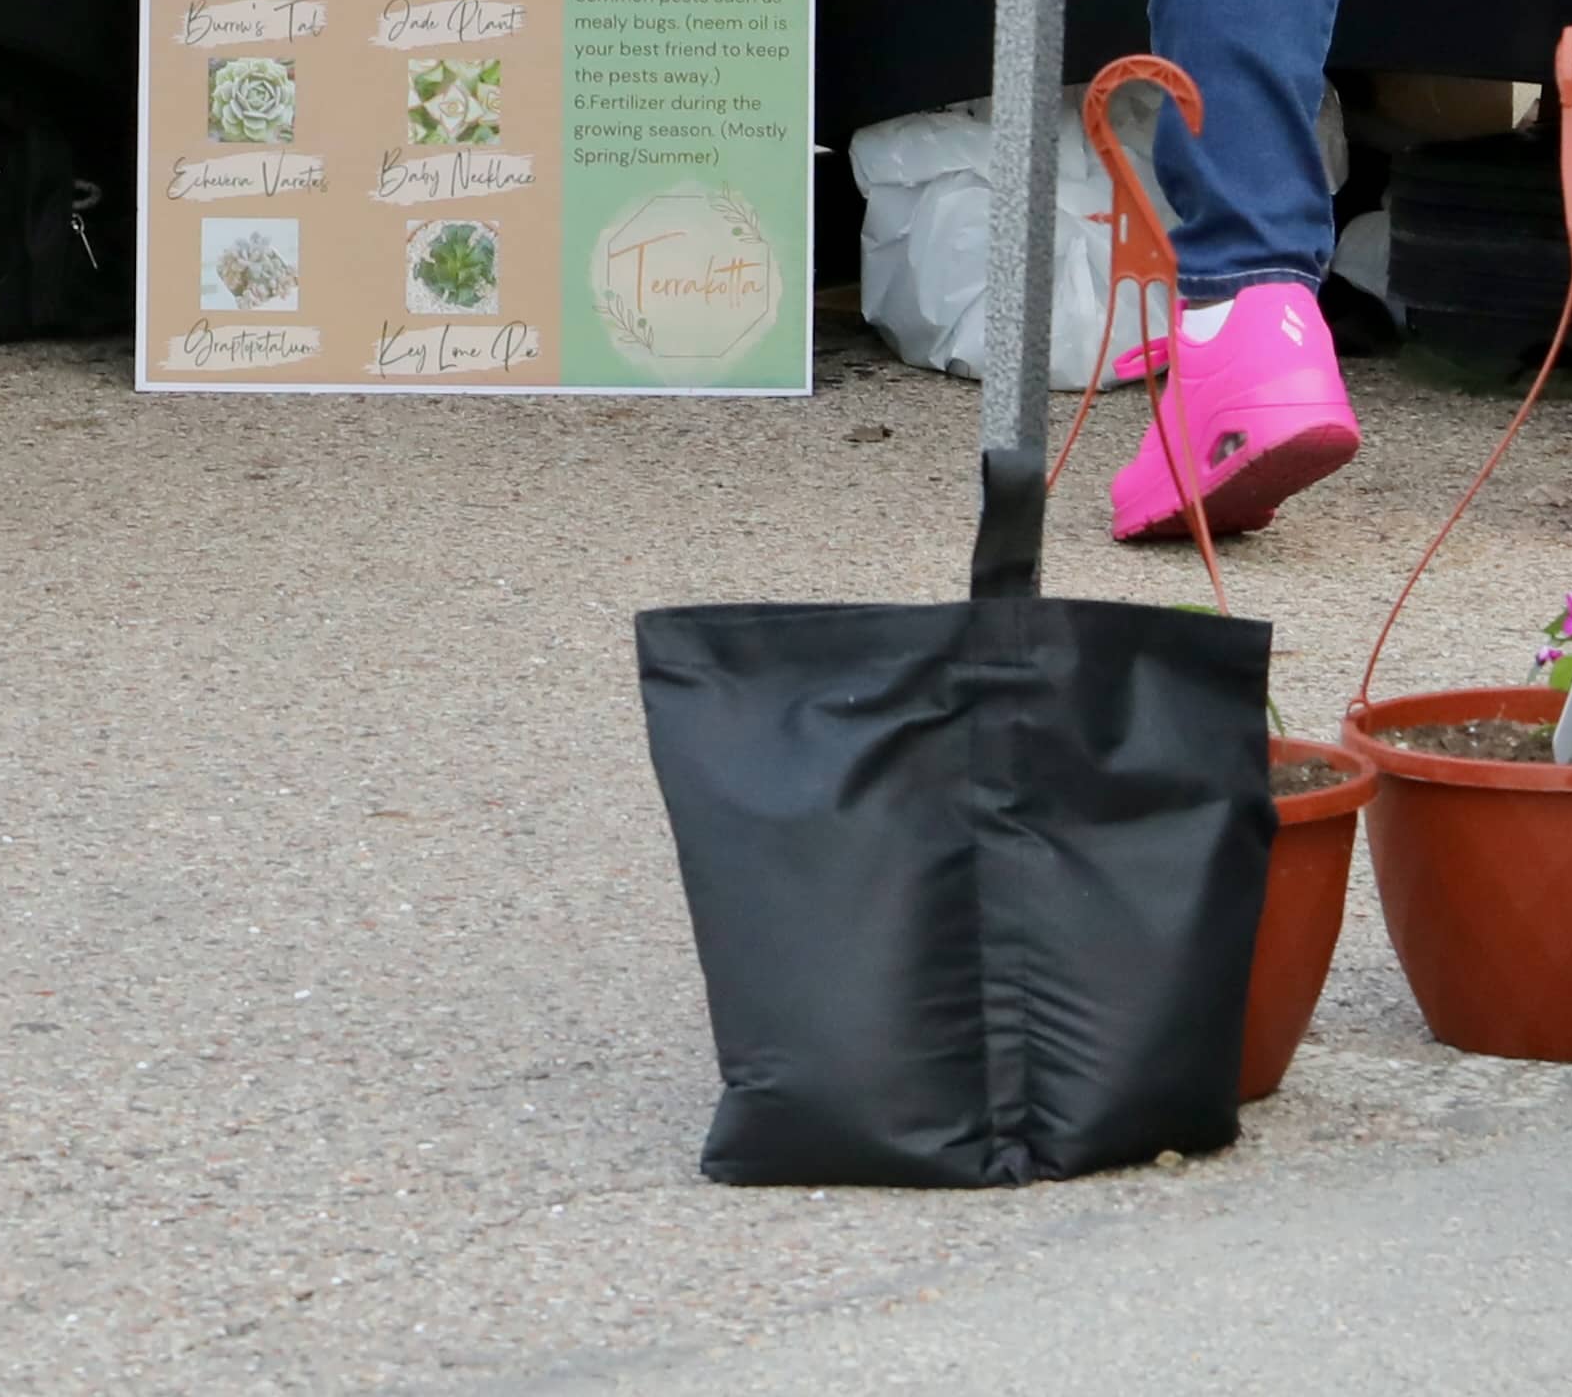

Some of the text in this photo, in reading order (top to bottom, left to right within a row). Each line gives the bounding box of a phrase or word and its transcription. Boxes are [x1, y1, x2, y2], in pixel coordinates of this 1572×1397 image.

[575, 13, 787, 34] mealy bugs. (neem oil is
[575, 41, 789, 60] your best friend to keep
[575, 68, 603, 84] the
[609, 69, 657, 87] pests
[671, 95, 727, 115] during
[733, 95, 761, 110] the
[574, 122, 642, 141] growing
[721, 121, 787, 140] (Mostly
[574, 147, 719, 168] Spring/Summer)
[379, 147, 537, 197] Baby Necklace
[608, 231, 761, 313] Terrakotta
